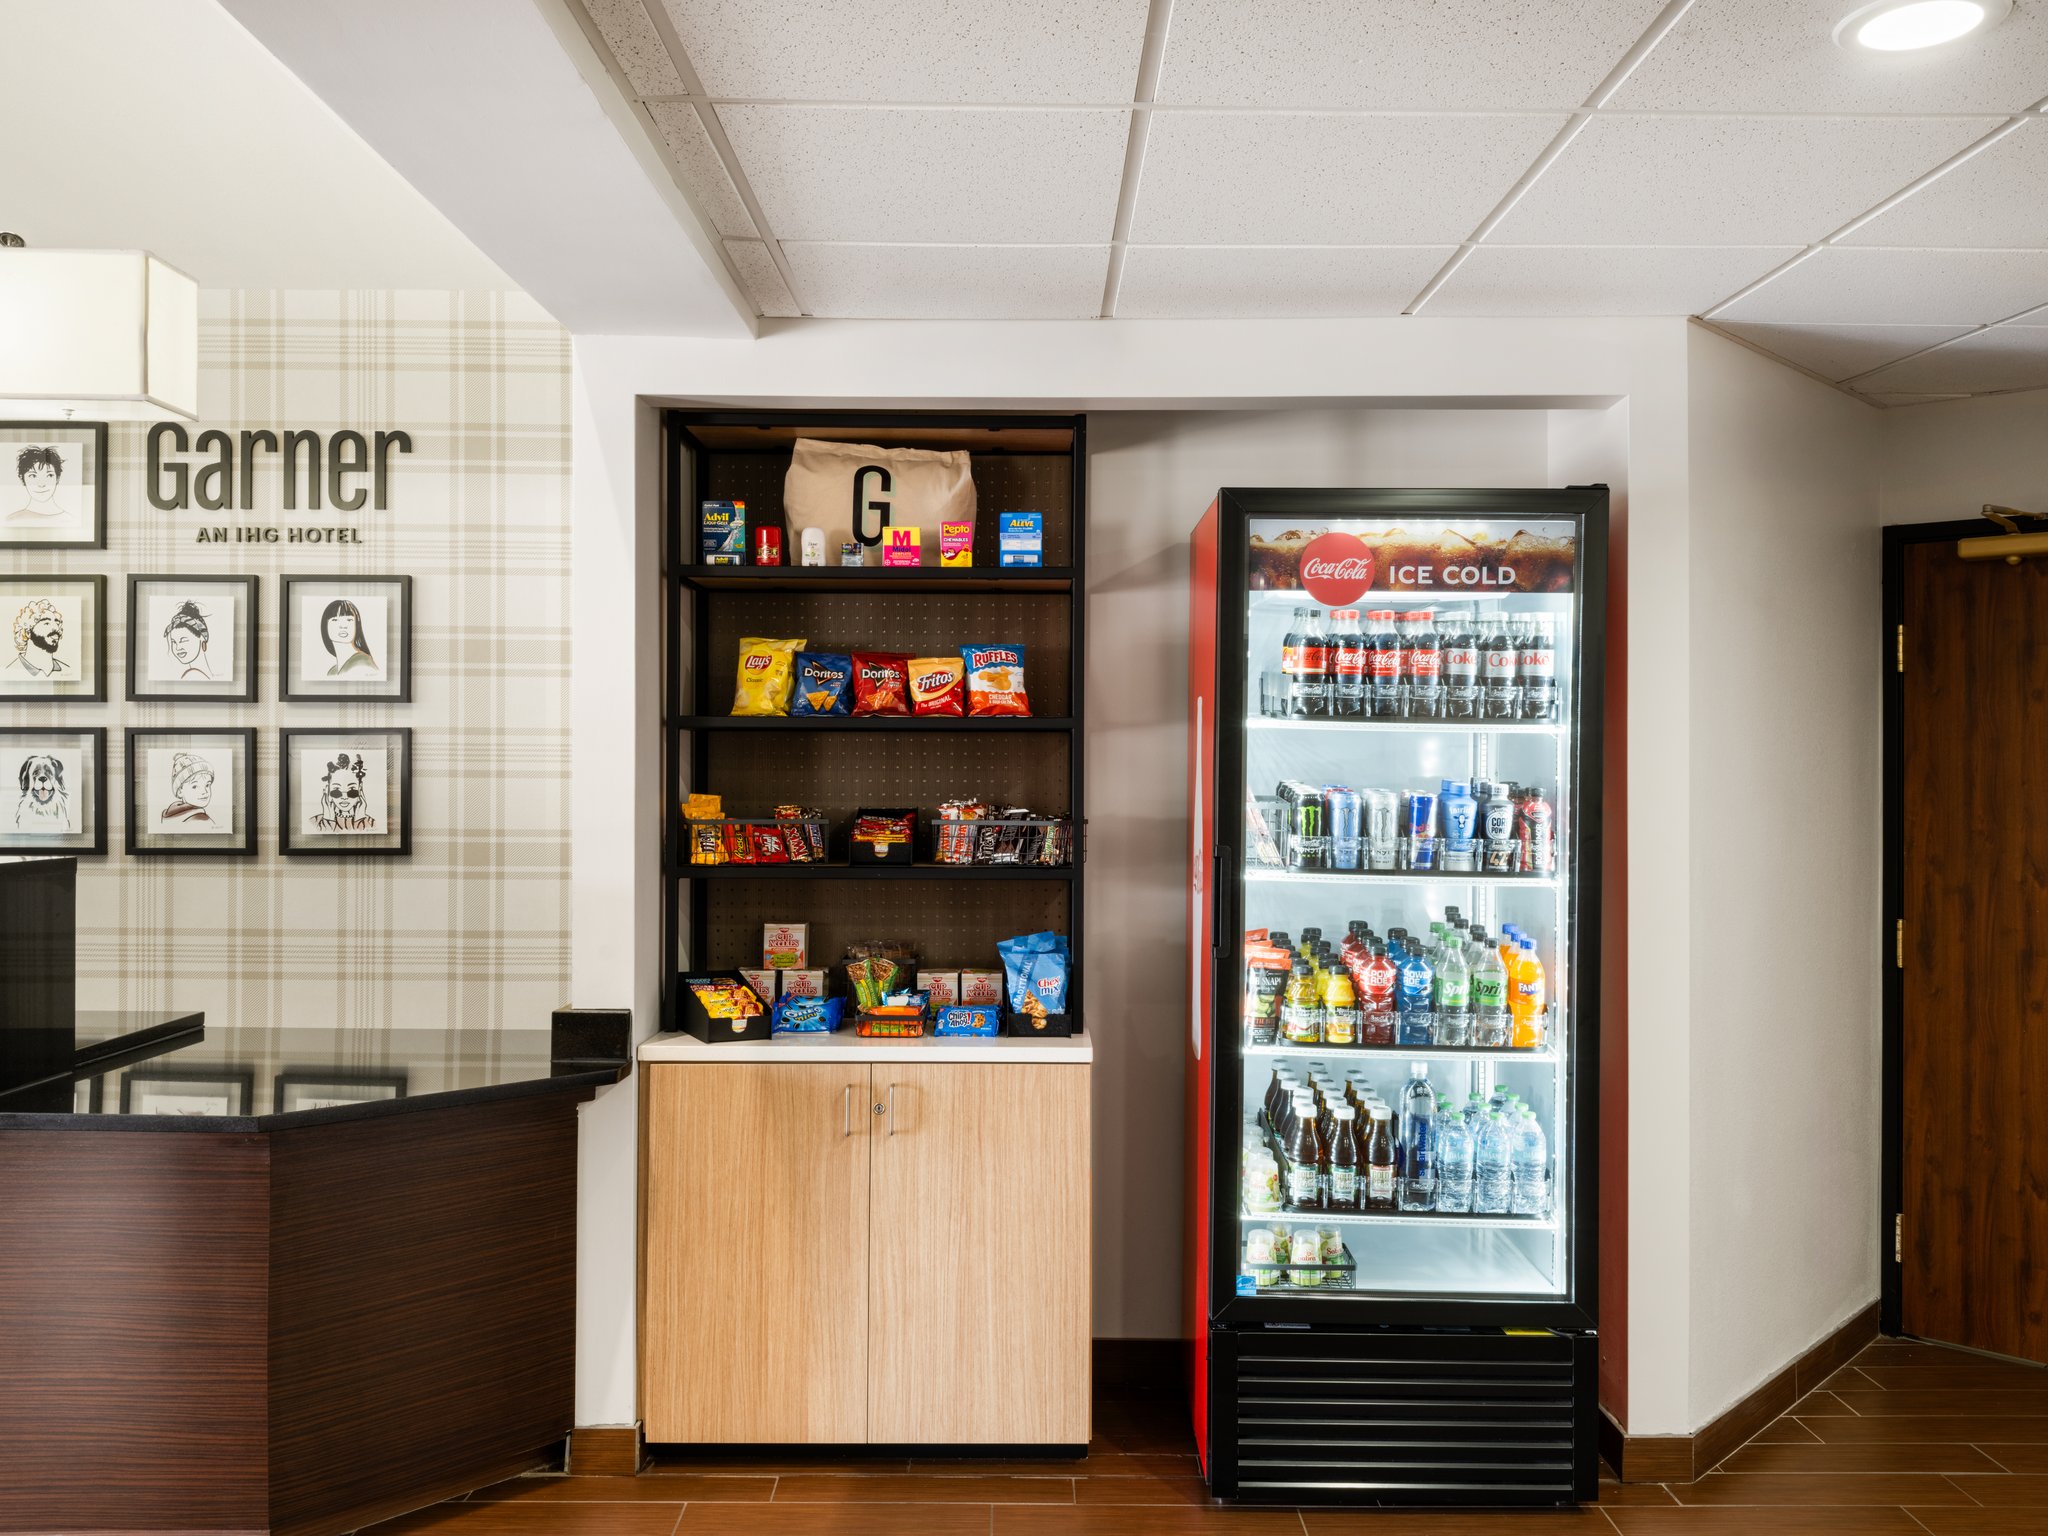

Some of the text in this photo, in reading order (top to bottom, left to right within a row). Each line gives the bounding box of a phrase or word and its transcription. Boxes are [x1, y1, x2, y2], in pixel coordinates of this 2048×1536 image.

[147, 421, 412, 511] Garner
[852, 465, 892, 547] G
[704, 513, 729, 521] Advil
[943, 524, 970, 534] Pepto
[196, 527, 363, 543] AN IHG HOTEL
[892, 530, 911, 546] M
[1304, 557, 1371, 580] Coca-Cola
[1389, 566, 1516, 585] ICE COLD
[746, 655, 771, 670] Lay's
[973, 650, 1018, 668] RUFFLES
[804, 667, 844, 679] Doritos
[862, 669, 900, 679] Doritos
[917, 672, 953, 692] Fritos
[776, 933, 794, 941] CUP
[768, 940, 799, 948] NOODLES
[793, 980, 811, 988] CUP
[929, 983, 946, 991] CUP
[973, 983, 991, 991] CUP
[1037, 977, 1060, 988] Chex
[787, 987, 818, 995] NOODLES
[966, 990, 997, 998] NOODLES
[948, 1012, 967, 1020] Chips
